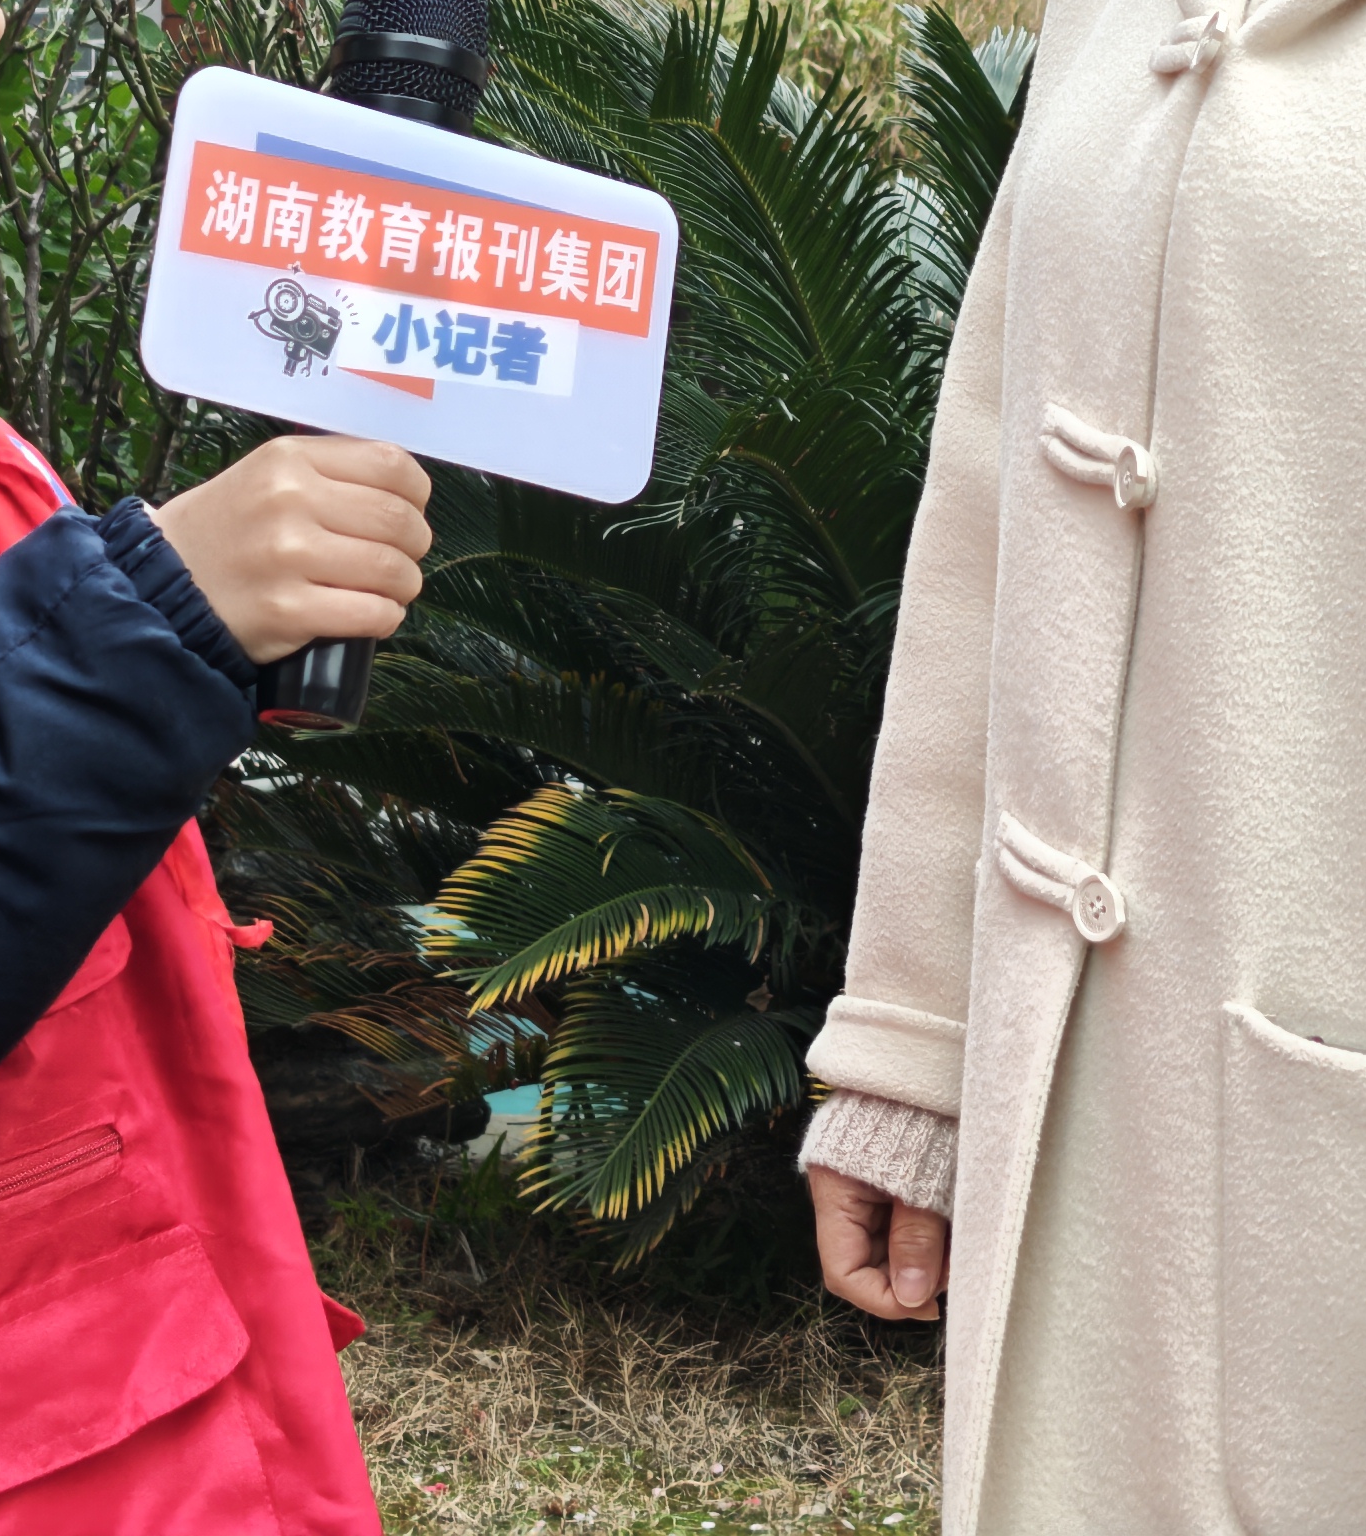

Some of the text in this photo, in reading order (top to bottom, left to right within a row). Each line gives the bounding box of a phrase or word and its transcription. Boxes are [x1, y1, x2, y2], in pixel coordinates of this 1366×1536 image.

[200, 168, 647, 313] 湖南教育报刊集团
[372, 303, 549, 386] 小记者
